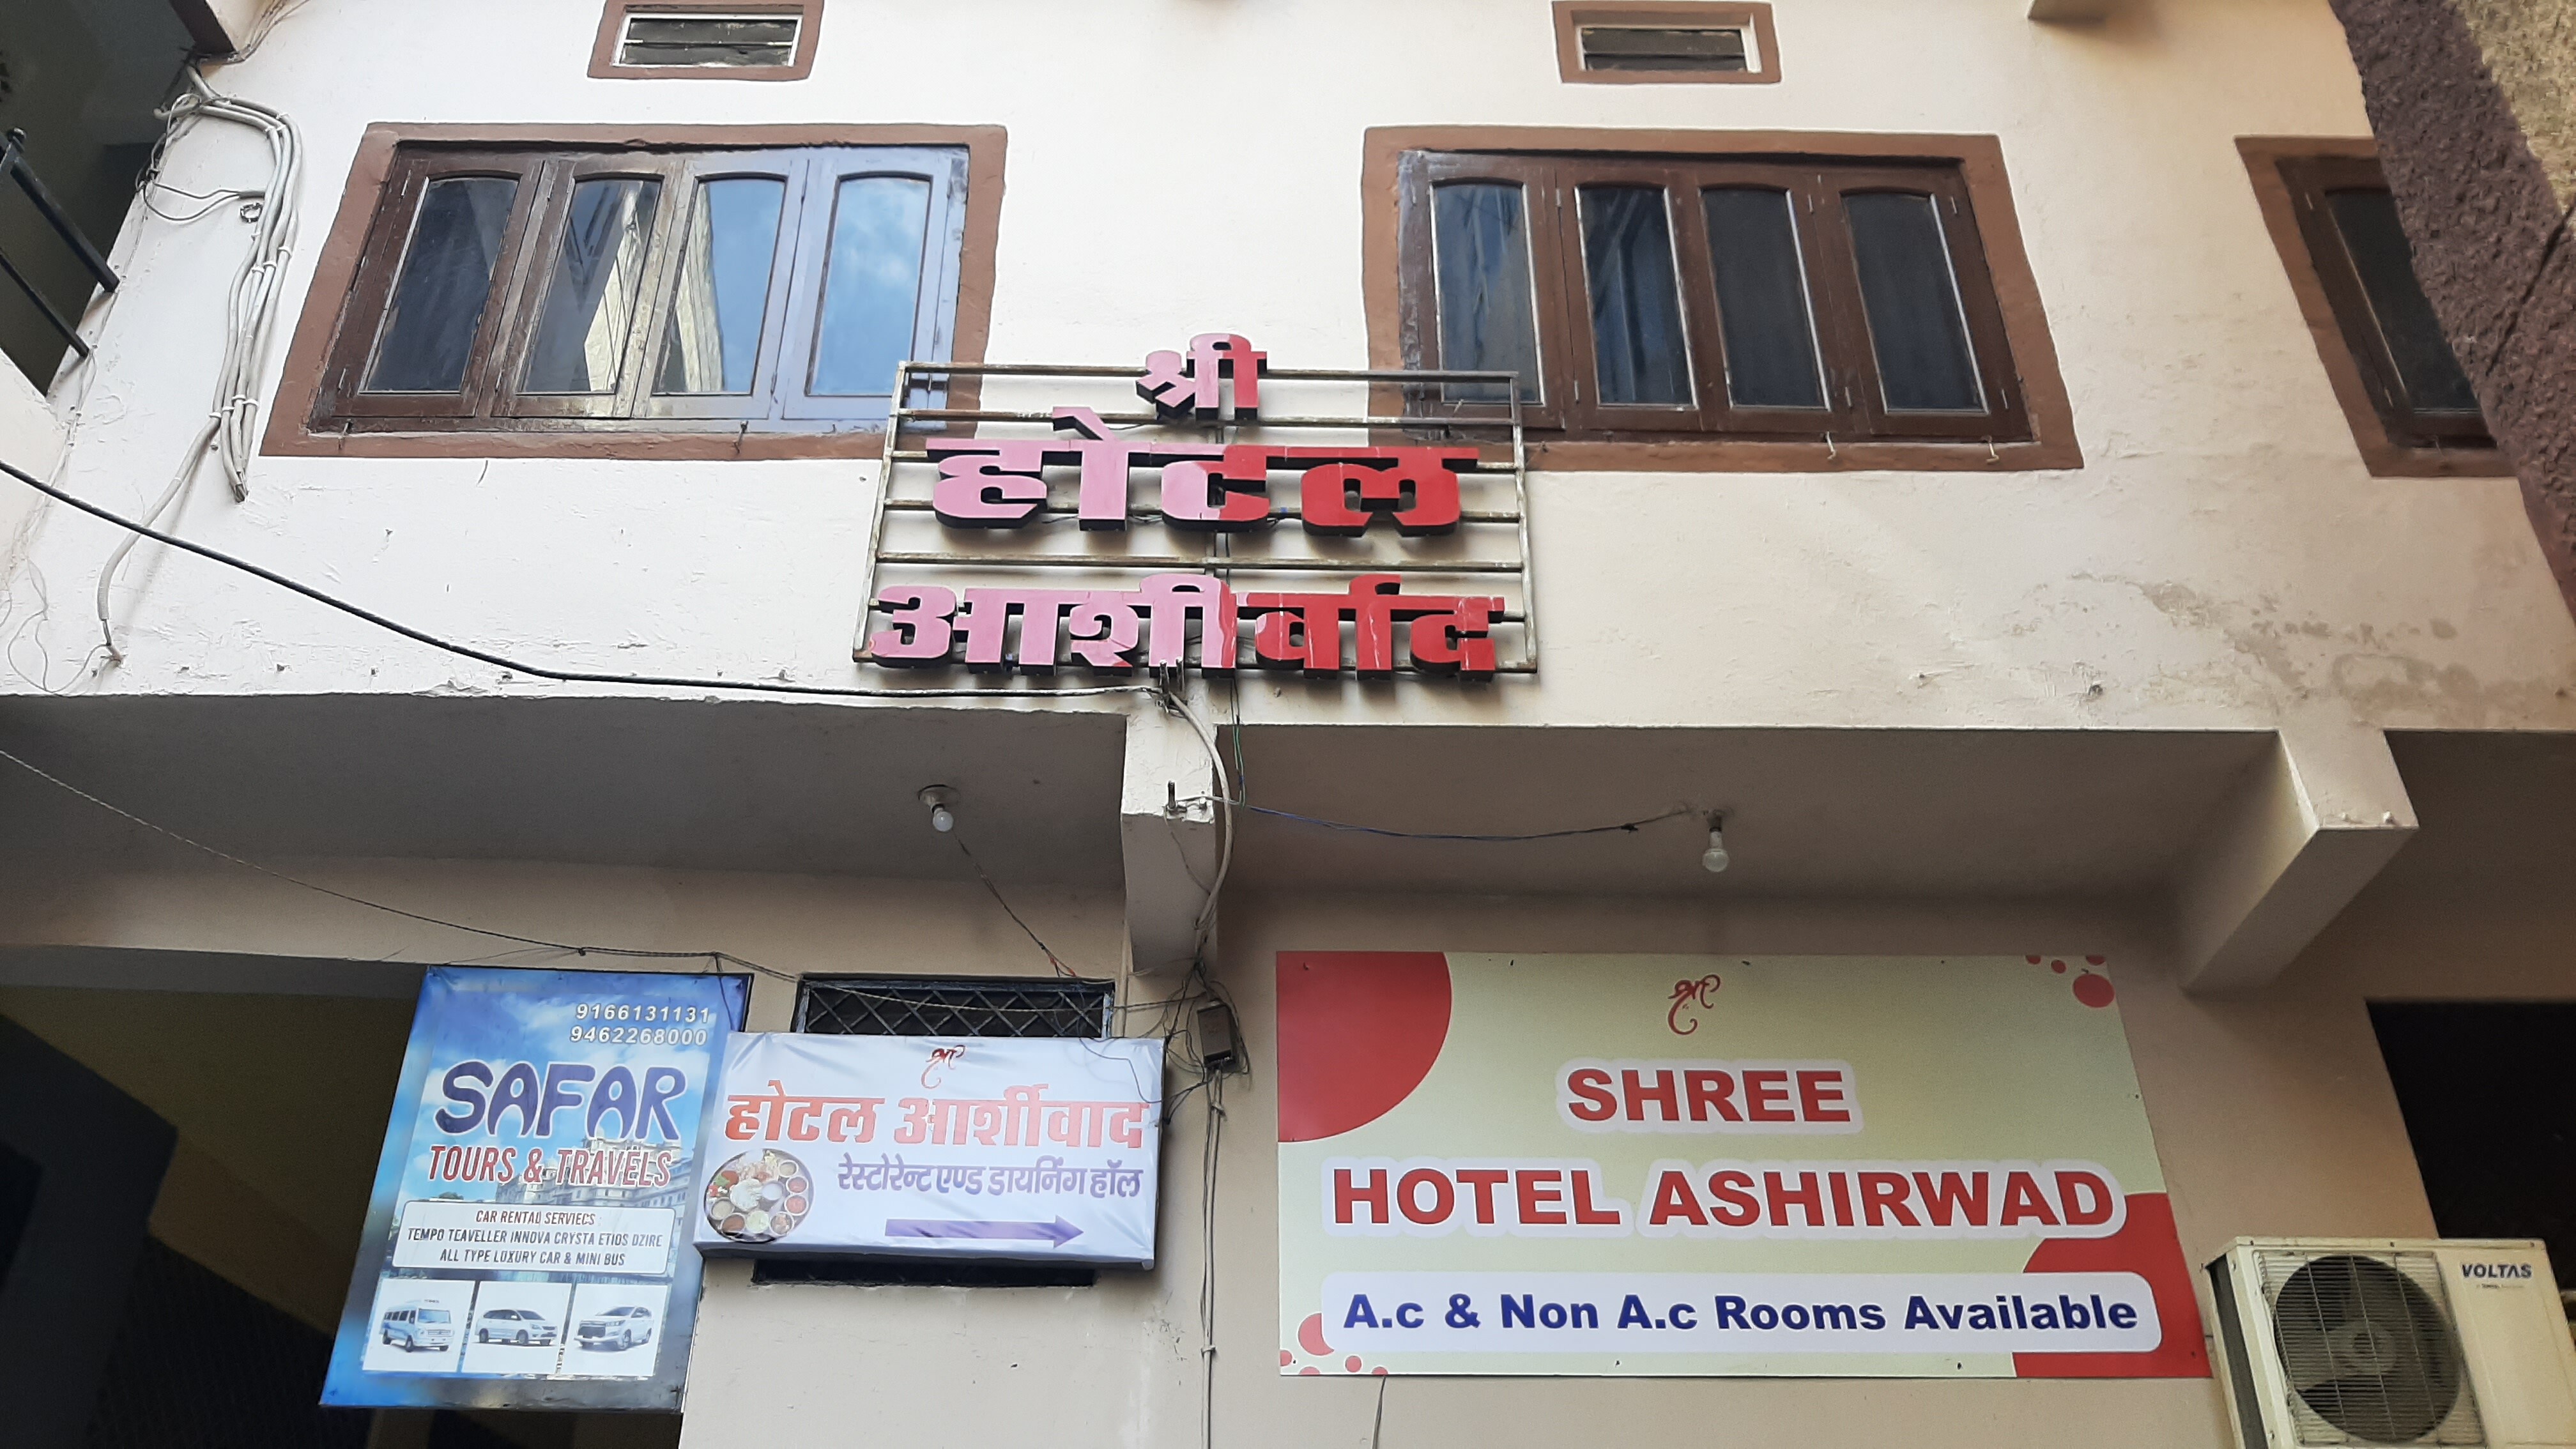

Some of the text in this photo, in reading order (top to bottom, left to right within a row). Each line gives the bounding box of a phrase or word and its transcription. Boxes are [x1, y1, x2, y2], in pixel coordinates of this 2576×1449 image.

[1135, 332, 1268, 418] श्री
[925, 406, 1479, 535] होटल
[867, 572, 1505, 681] आशीर्वाद
[576, 1003, 709, 1023] 9166131131
[570, 1026, 707, 1045] 9462268000
[434, 1061, 686, 1140] SAFAR
[724, 1080, 885, 1141] होटल
[1567, 1068, 1851, 1123] SHREE
[429, 1146, 672, 1186] TOURS & TRAVELS
[1090, 1159, 1144, 1198] हॉल
[476, 1210, 497, 1223] CAR
[1333, 1167, 2116, 1227] HOTEL ASHIRWAD
[408, 1228, 445, 1241] TEMPO
[510, 1230, 550, 1244] INNOVA
[554, 1232, 595, 1245] CRYSTA
[598, 1233, 629, 1246] ETIOS
[632, 1234, 663, 1247] DZIRE
[440, 1249, 459, 1262] ALL
[464, 1249, 491, 1262] TYPE
[539, 1251, 560, 1264] CAR
[564, 1252, 571, 1264] &
[575, 1252, 601, 1265] MINI
[604, 1253, 625, 1266] BUS
[2462, 1264, 2531, 1278] VOLTAS
[1343, 1293, 2138, 1330] A.c & Non A.c Rooms Available
